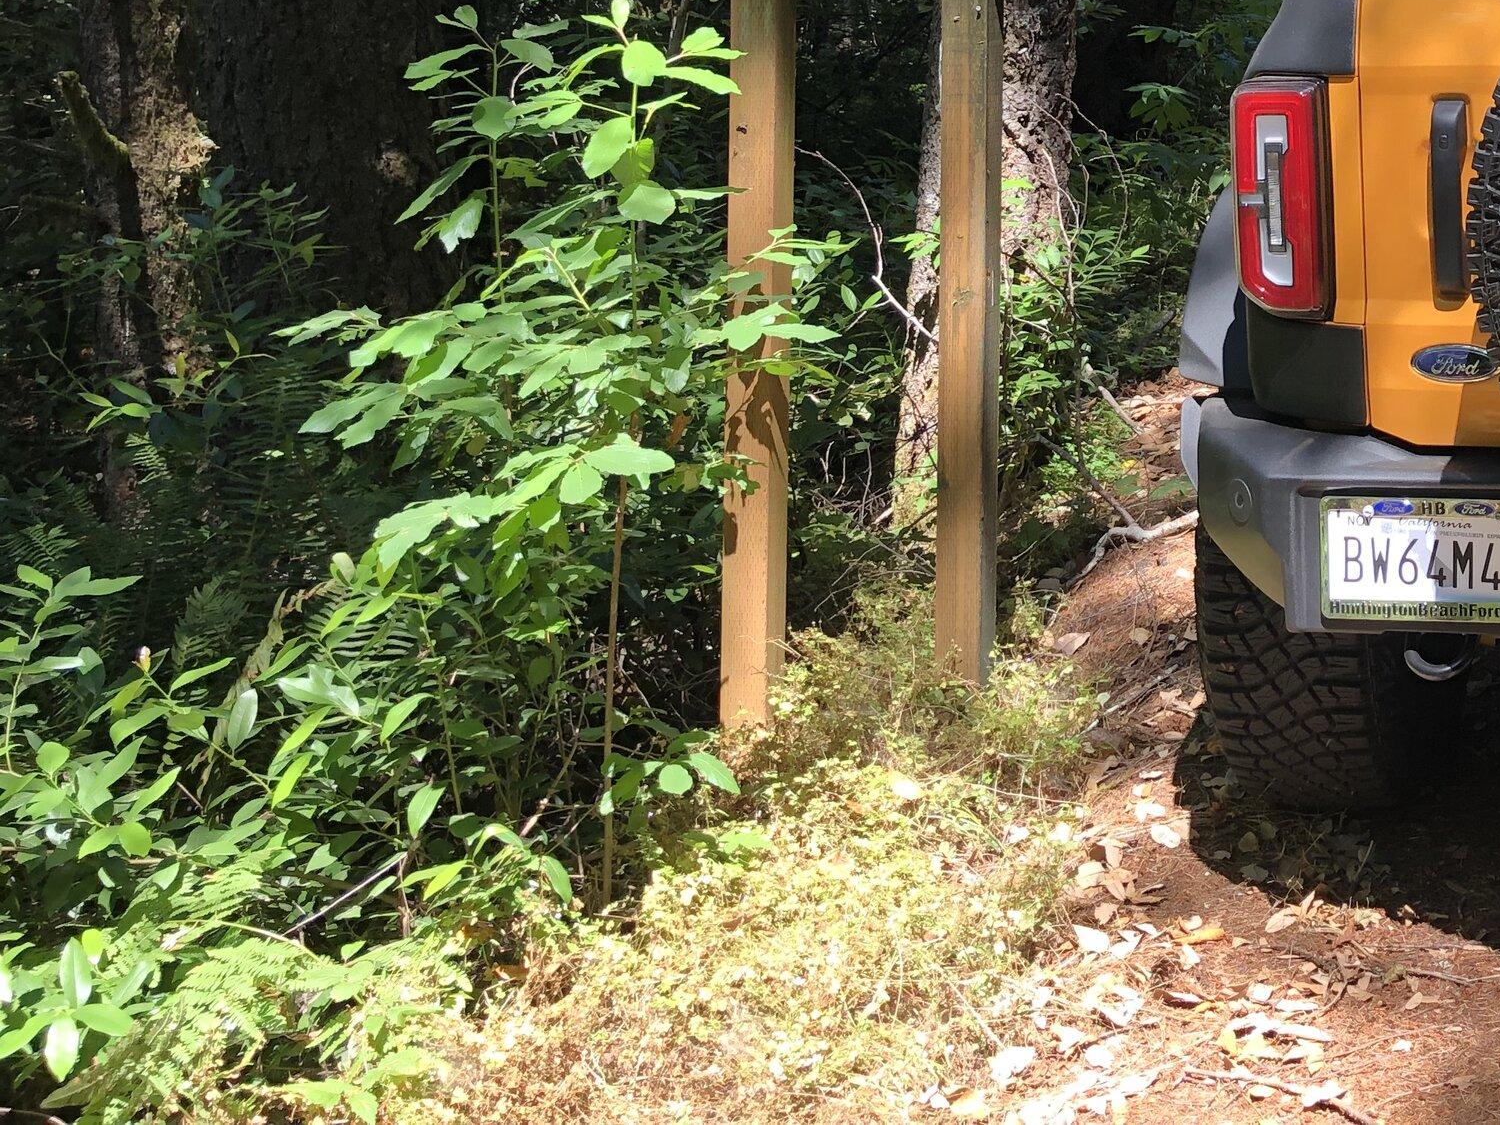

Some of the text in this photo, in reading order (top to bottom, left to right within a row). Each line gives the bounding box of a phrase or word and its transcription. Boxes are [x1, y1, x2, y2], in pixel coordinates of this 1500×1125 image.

[1430, 354, 1480, 375] Ford
[1421, 502, 1446, 515] HB
[1460, 502, 1489, 516] Ford
[1399, 516, 1473, 535] California
